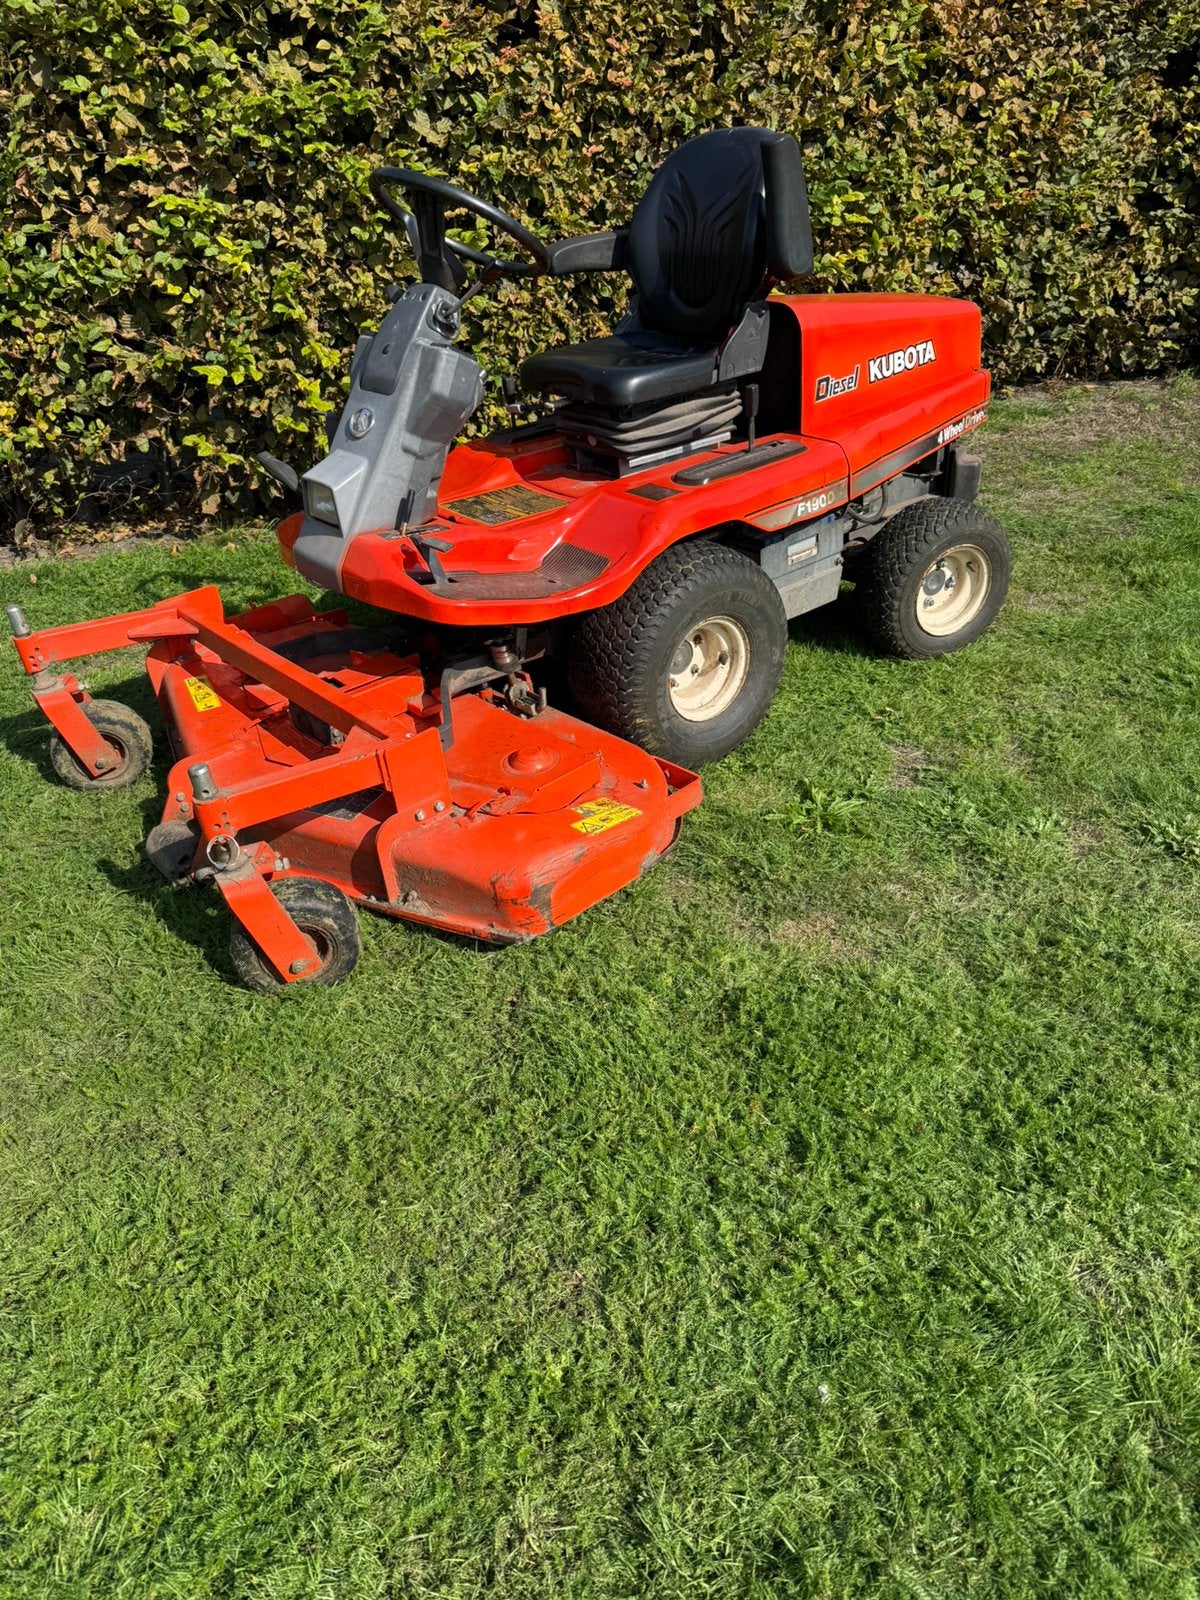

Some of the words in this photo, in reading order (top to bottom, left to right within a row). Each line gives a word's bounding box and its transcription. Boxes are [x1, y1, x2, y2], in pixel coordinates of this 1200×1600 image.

[868, 339, 936, 384] KUBOTA
[815, 365, 860, 403] Diesel
[944, 417, 966, 442] Wheel
